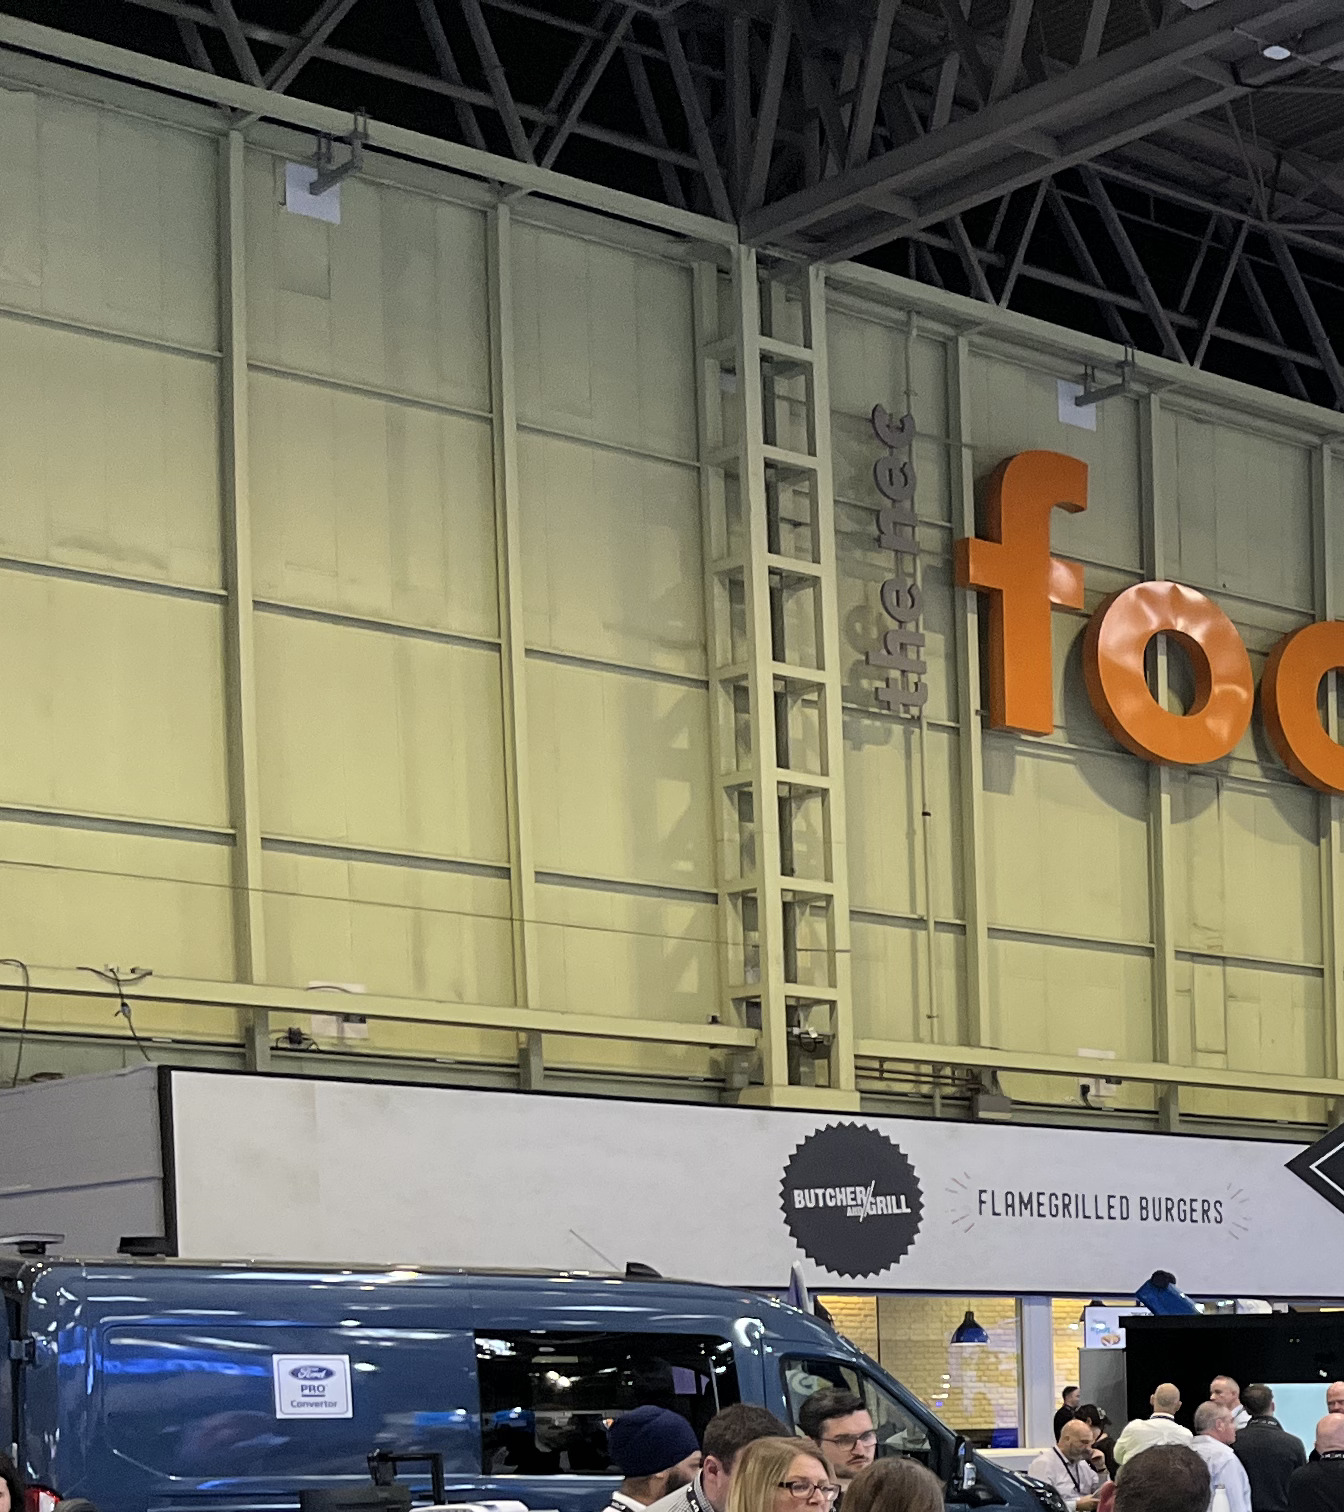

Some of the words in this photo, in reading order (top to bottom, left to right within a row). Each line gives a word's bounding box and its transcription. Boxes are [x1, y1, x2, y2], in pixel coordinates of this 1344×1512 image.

[871, 403, 920, 555] nec
[865, 577, 928, 714] the
[793, 1186, 867, 1209] BUTCHER
[866, 1194, 912, 1216] GRILL
[978, 1189, 1130, 1221] FLAMEGRILLED
[1139, 1196, 1224, 1224] BURGERS
[300, 1384, 326, 1393] PRO
[290, 1399, 338, 1408] Convertor
